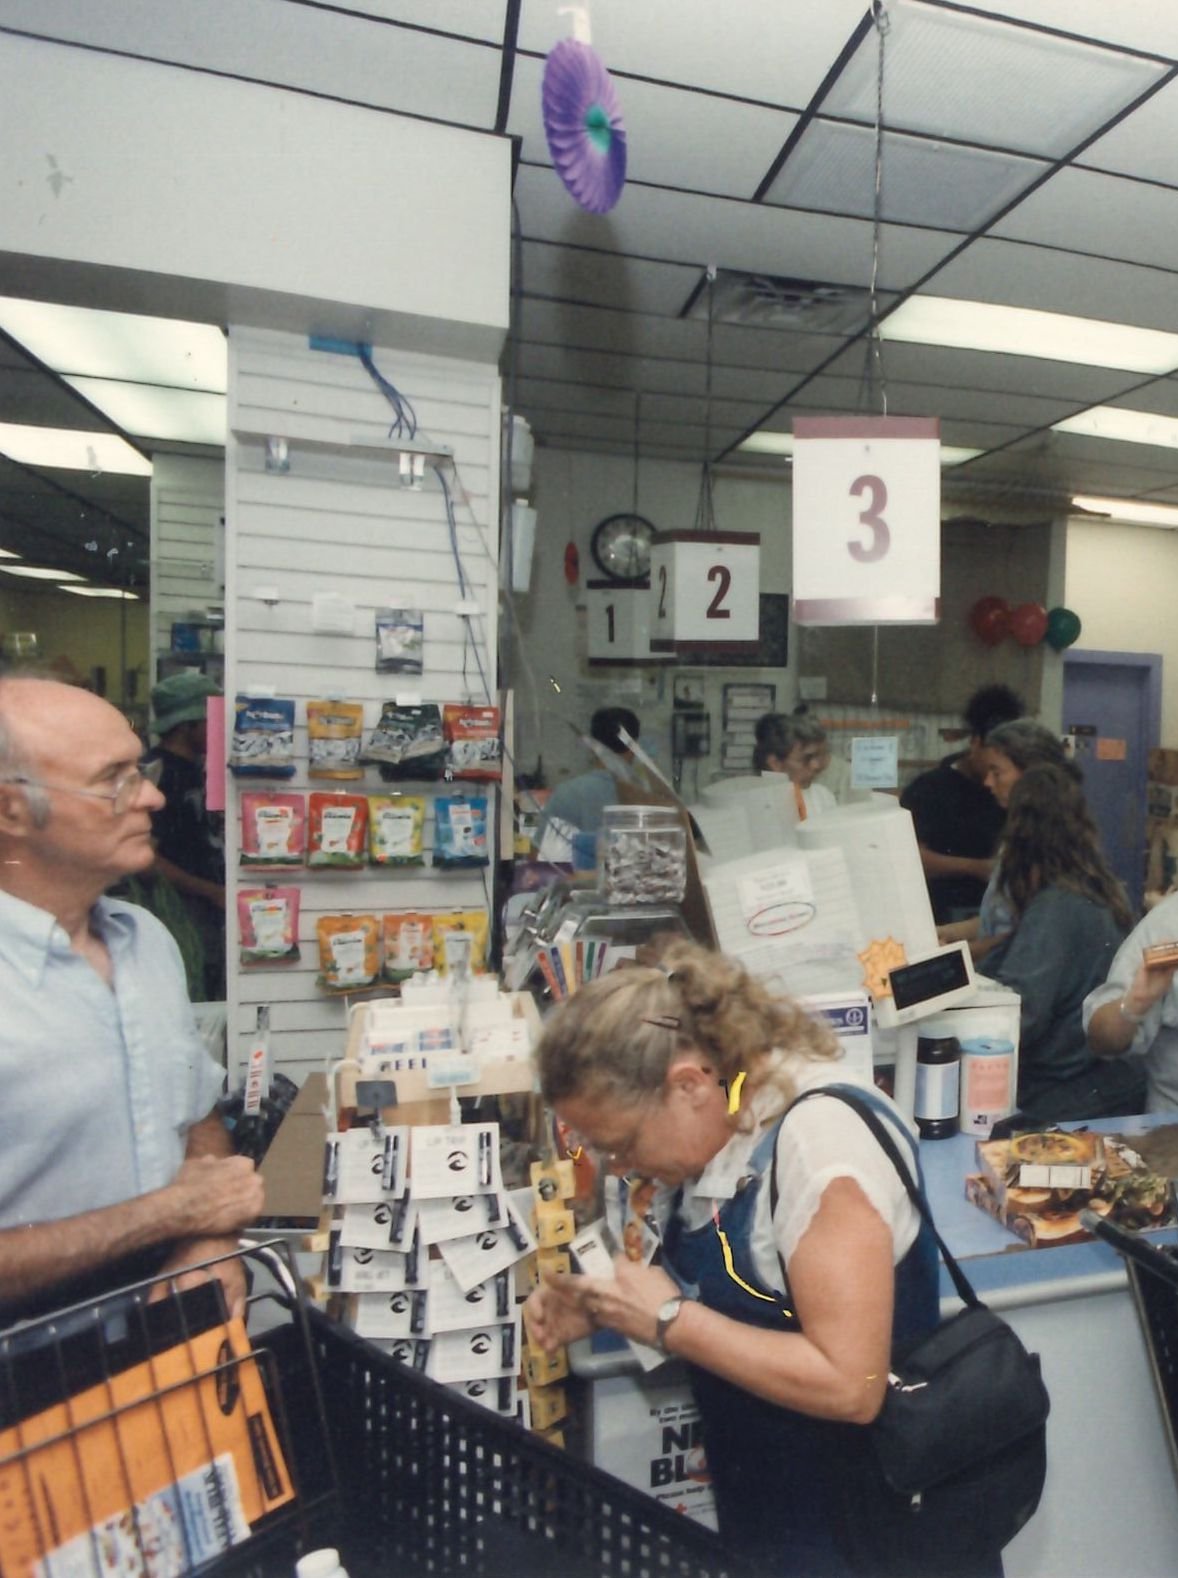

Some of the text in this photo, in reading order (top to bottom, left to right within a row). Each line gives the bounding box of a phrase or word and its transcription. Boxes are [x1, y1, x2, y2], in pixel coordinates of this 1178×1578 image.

[847, 474, 890, 563] 3
[658, 565, 667, 618] 2
[707, 565, 731, 618] 2
[606, 604, 615, 642] 1
